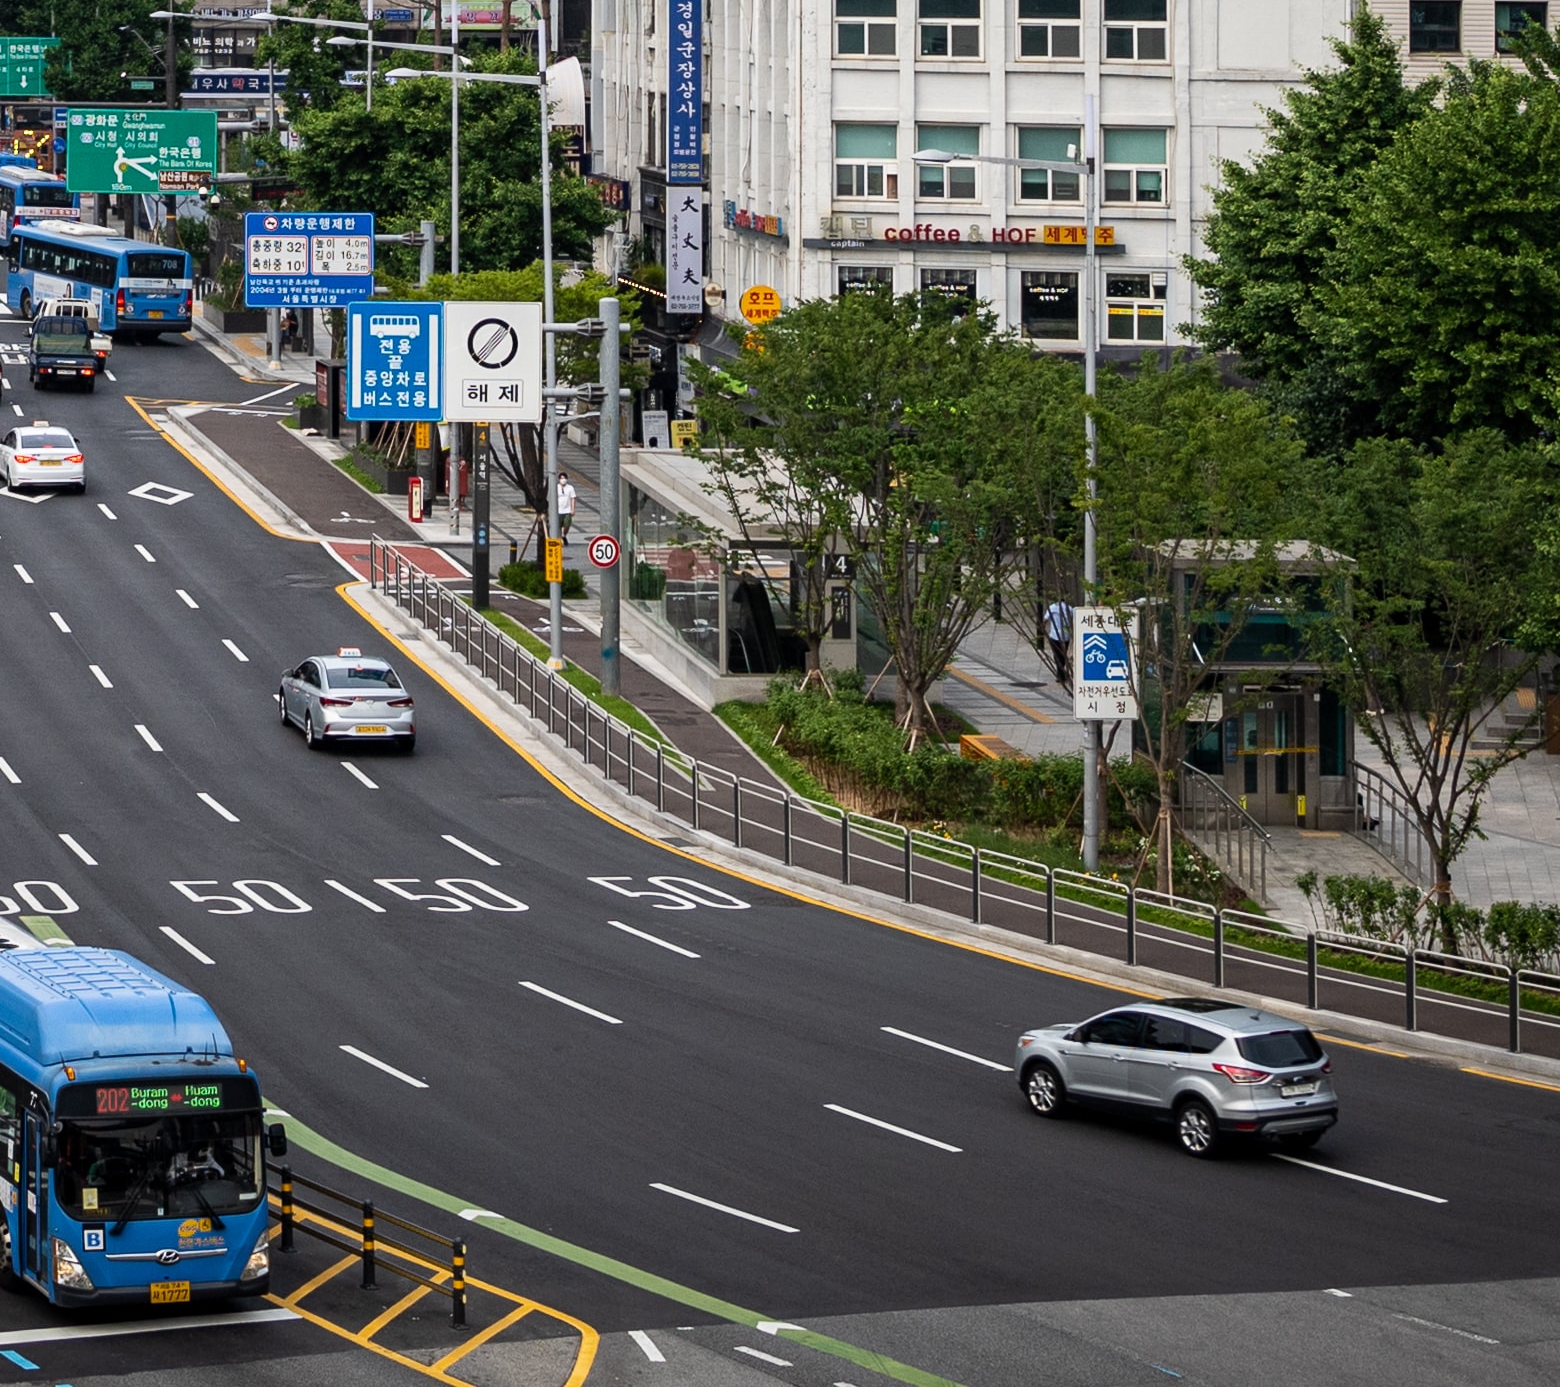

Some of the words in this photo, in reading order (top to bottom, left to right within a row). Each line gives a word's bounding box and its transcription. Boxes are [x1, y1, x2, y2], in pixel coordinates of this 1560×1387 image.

[676, 0, 696, 119] 경일군장상사
[85, 114, 119, 127] 광화문
[95, 130, 117, 142] 시청
[125, 130, 159, 143] 시의회
[158, 146, 202, 159] 한국은행
[280, 217, 356, 231] 차량운행제한
[681, 195, 700, 285] 大丈夫
[884, 223, 961, 243] coffee
[968, 224, 984, 243] &
[992, 227, 1037, 243] HOF
[252, 240, 282, 254] 총중량
[315, 238, 335, 249] 높이
[830, 239, 865, 250] captain
[315, 250, 335, 261] 길이
[341, 251, 368, 260] 16.7m
[162, 259, 178, 269] 708
[252, 258, 282, 272] 축하중
[321, 261, 330, 273] 폭
[346, 262, 368, 272] 2.5m
[282, 294, 337, 304] 서울특별시장
[748, 291, 775, 306] 호프
[379, 339, 412, 355] 전용
[387, 355, 404, 370] 끝
[364, 370, 427, 387] 중앙차로
[363, 391, 427, 407] 버스전용
[467, 383, 519, 403] 해제
[478, 453, 487, 480] 서울역
[594, 543, 614, 560] 50
[835, 555, 847, 573] 4
[170, 878, 313, 915] 50
[374, 877, 531, 913] 50
[587, 874, 752, 912] 50
[130, 1086, 168, 1099] Buram
[184, 1084, 219, 1096] Huam
[96, 1087, 130, 1113] 202
[130, 1097, 168, 1110] -dong
[183, 1095, 221, 1108] -dong
[86, 1232, 101, 1247] B
[162, 1288, 189, 1300] 1777
